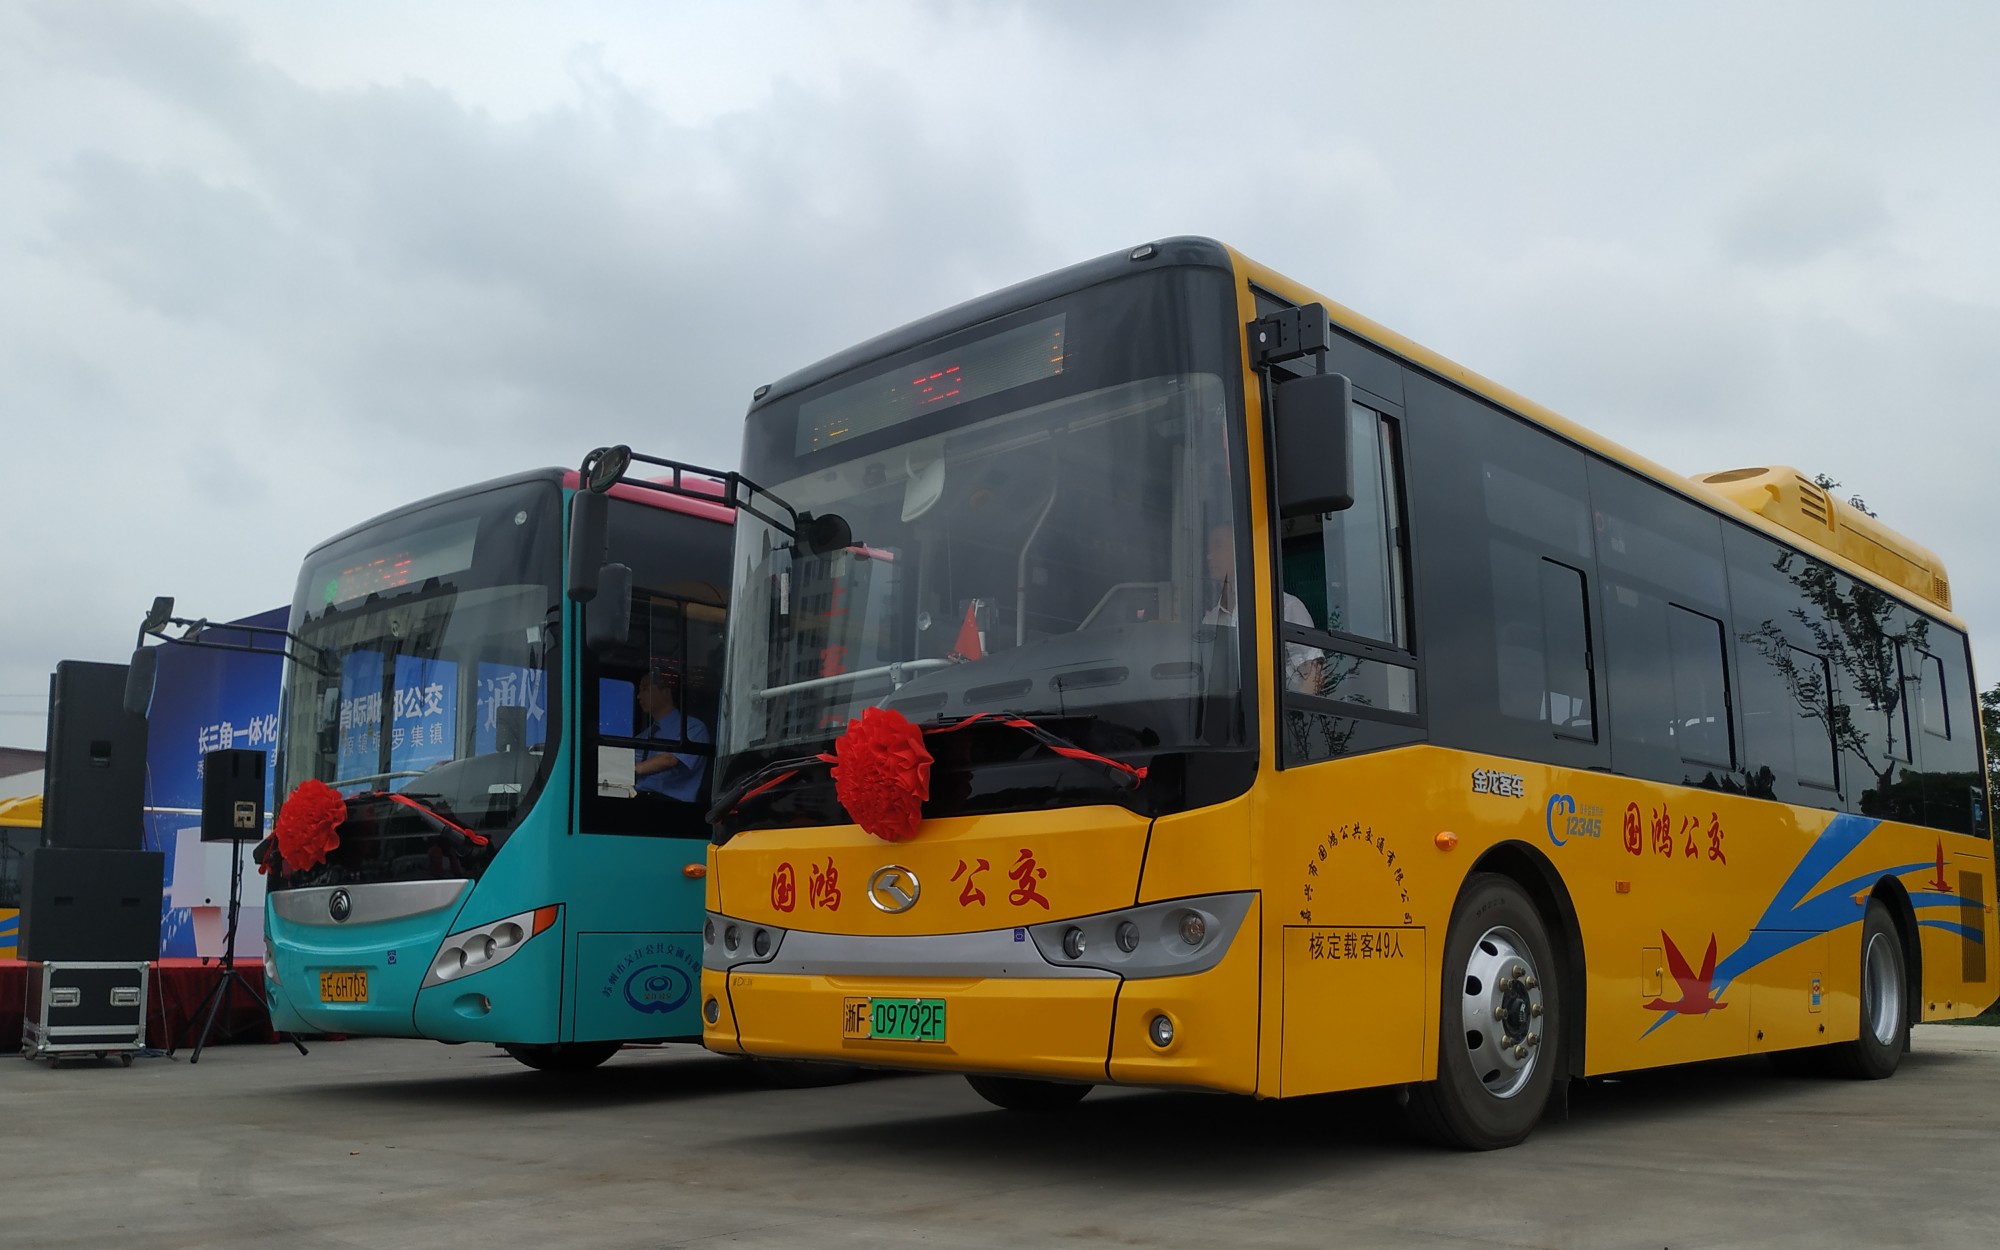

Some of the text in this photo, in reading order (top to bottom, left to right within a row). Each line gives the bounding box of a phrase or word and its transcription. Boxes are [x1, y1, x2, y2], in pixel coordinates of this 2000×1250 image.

[477, 668, 545, 732] 通仪
[198, 713, 277, 754] 长三角一体化
[1472, 768, 1525, 798] 金龙客车
[1566, 816, 1602, 838] 12345
[1623, 801, 1727, 866] 国鸿公交
[770, 848, 1051, 913] 国鸿 公交
[1309, 932, 1404, 960] 核定载客49人
